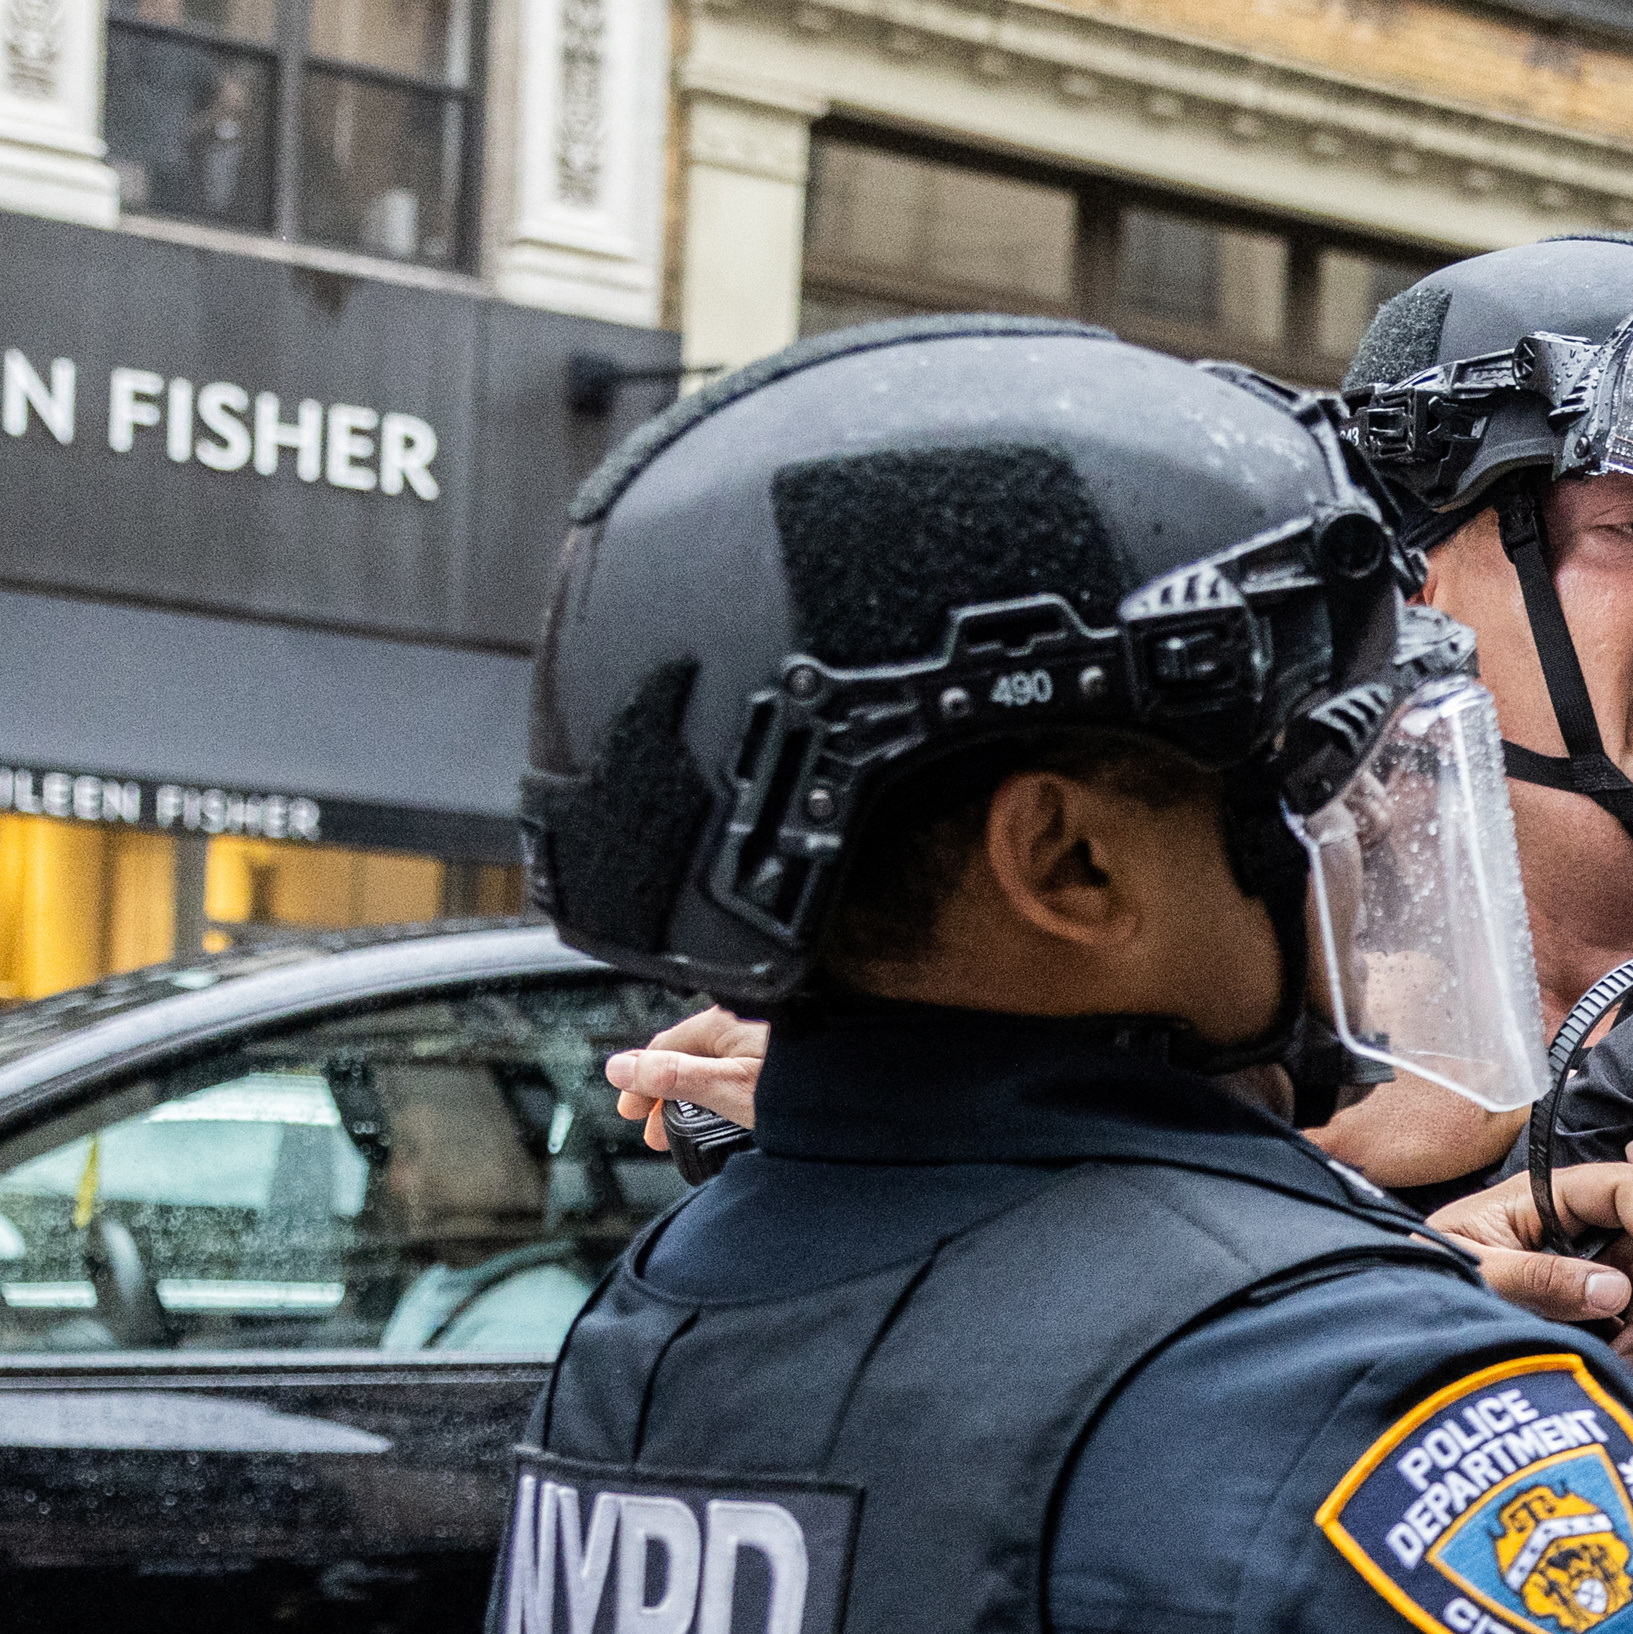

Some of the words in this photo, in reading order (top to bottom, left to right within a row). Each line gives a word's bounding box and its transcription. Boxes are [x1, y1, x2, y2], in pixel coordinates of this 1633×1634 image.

[108, 366, 440, 501] FISHER
[989, 667, 1054, 708] 490
[155, 784, 320, 842] FISHER
[1385, 1408, 1610, 1570] DEPARTMENT
[1396, 1388, 1540, 1492] POLICE
